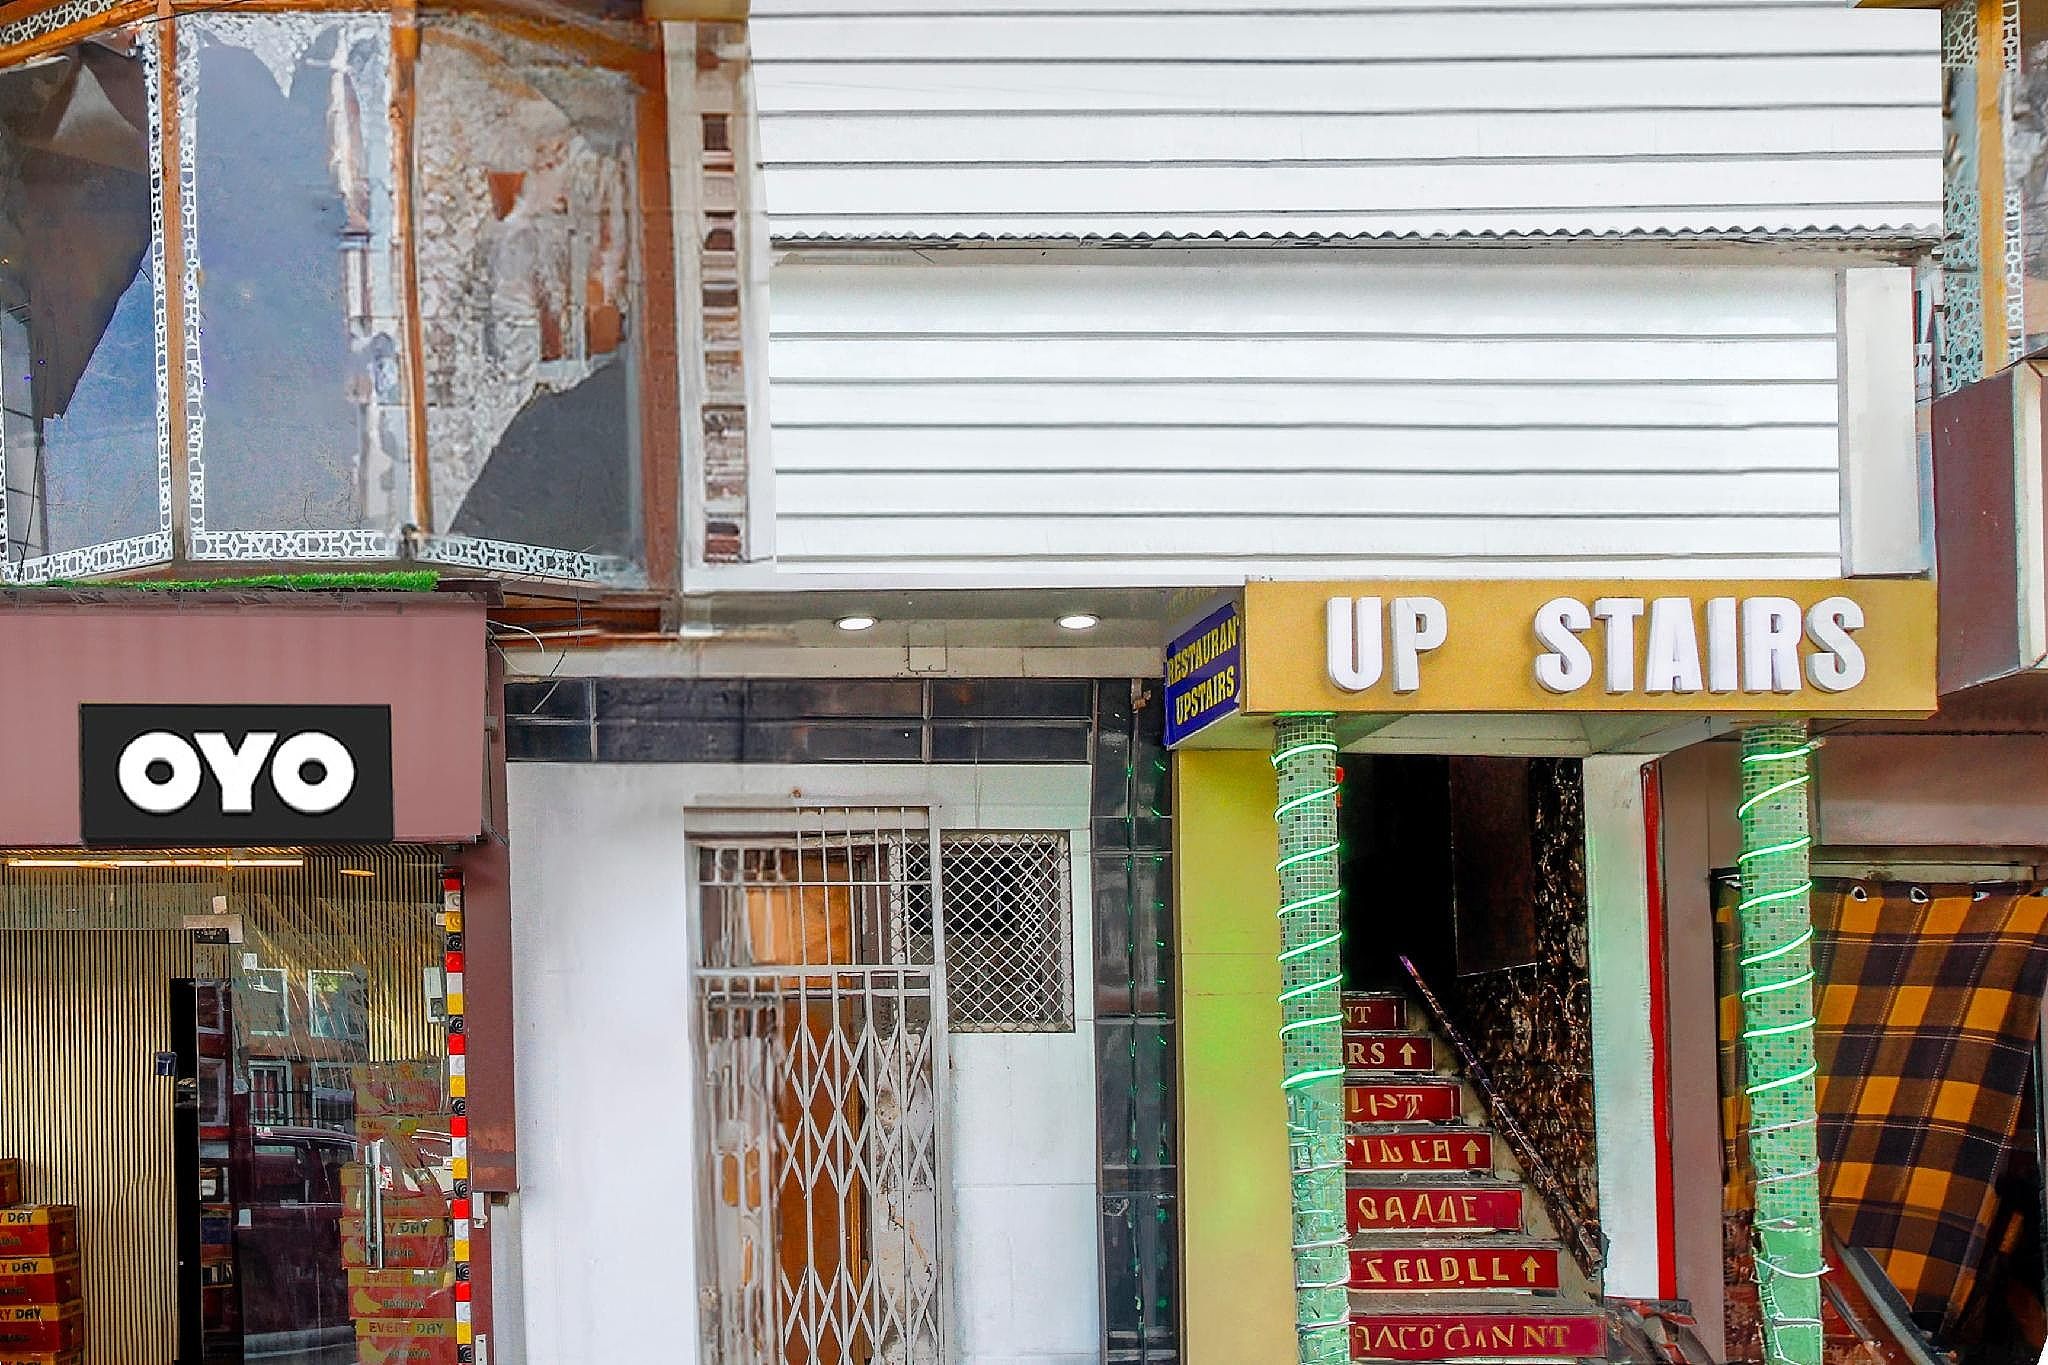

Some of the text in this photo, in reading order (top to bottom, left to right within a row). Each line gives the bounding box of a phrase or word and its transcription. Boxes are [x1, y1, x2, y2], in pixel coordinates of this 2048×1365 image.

[1167, 616, 1239, 687] RESTAURAN
[1327, 596, 1865, 694] UP STAIRS
[1175, 665, 1235, 726] UPSTAIRS
[117, 731, 356, 814] OYO
[8, 1212, 33, 1223] DAY
[12, 1261, 38, 1273] DAY
[16, 1308, 41, 1320] DAY
